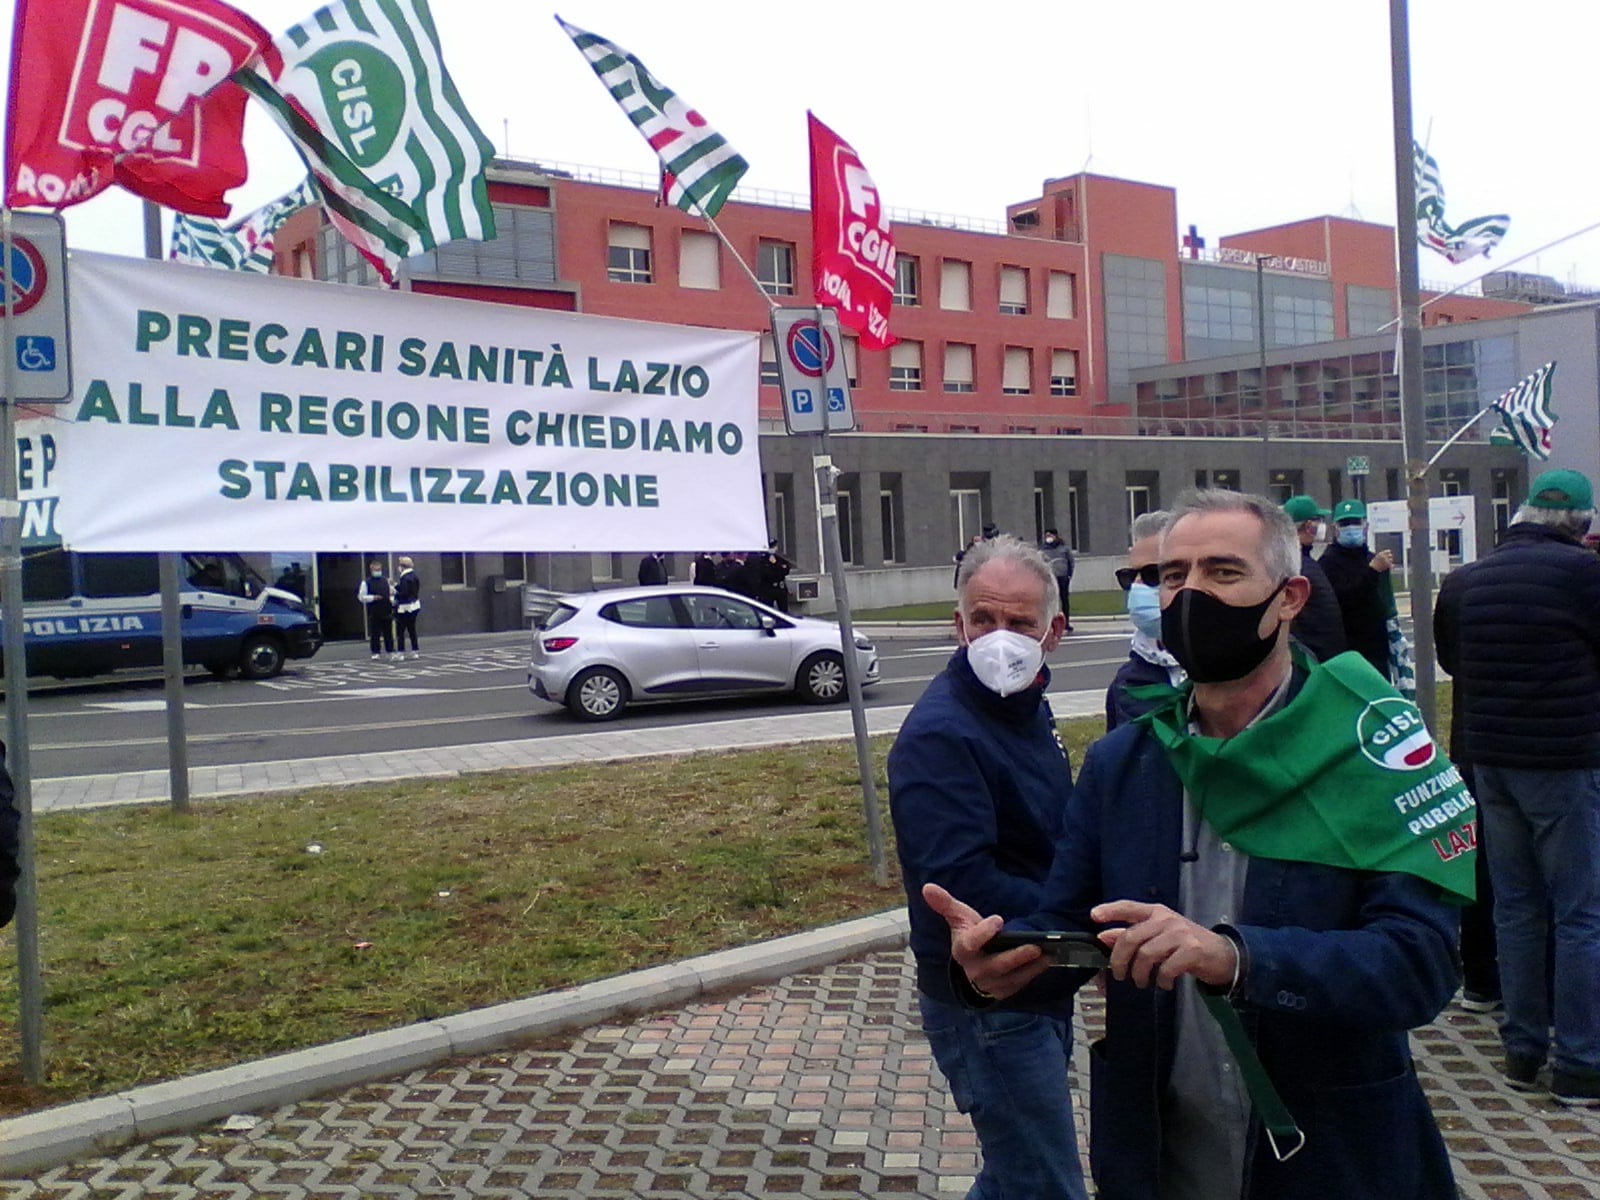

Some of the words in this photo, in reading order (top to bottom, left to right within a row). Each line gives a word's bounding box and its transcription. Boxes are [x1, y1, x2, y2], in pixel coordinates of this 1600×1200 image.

[97, 3, 233, 114] FP
[331, 58, 377, 156] CISL
[16, 161, 100, 203] ROM
[848, 221, 897, 281] CGIL
[135, 309, 385, 373] PRECARI
[397, 337, 574, 389] SANITÀ
[588, 356, 710, 399] LAZIO
[75, 379, 241, 430] ALLA
[259, 392, 491, 444] REGIONE
[506, 409, 744, 456] CHIEDIAMO
[217, 458, 660, 508] STABILIZZAZIONE
[1371, 709, 1420, 746] CISL
